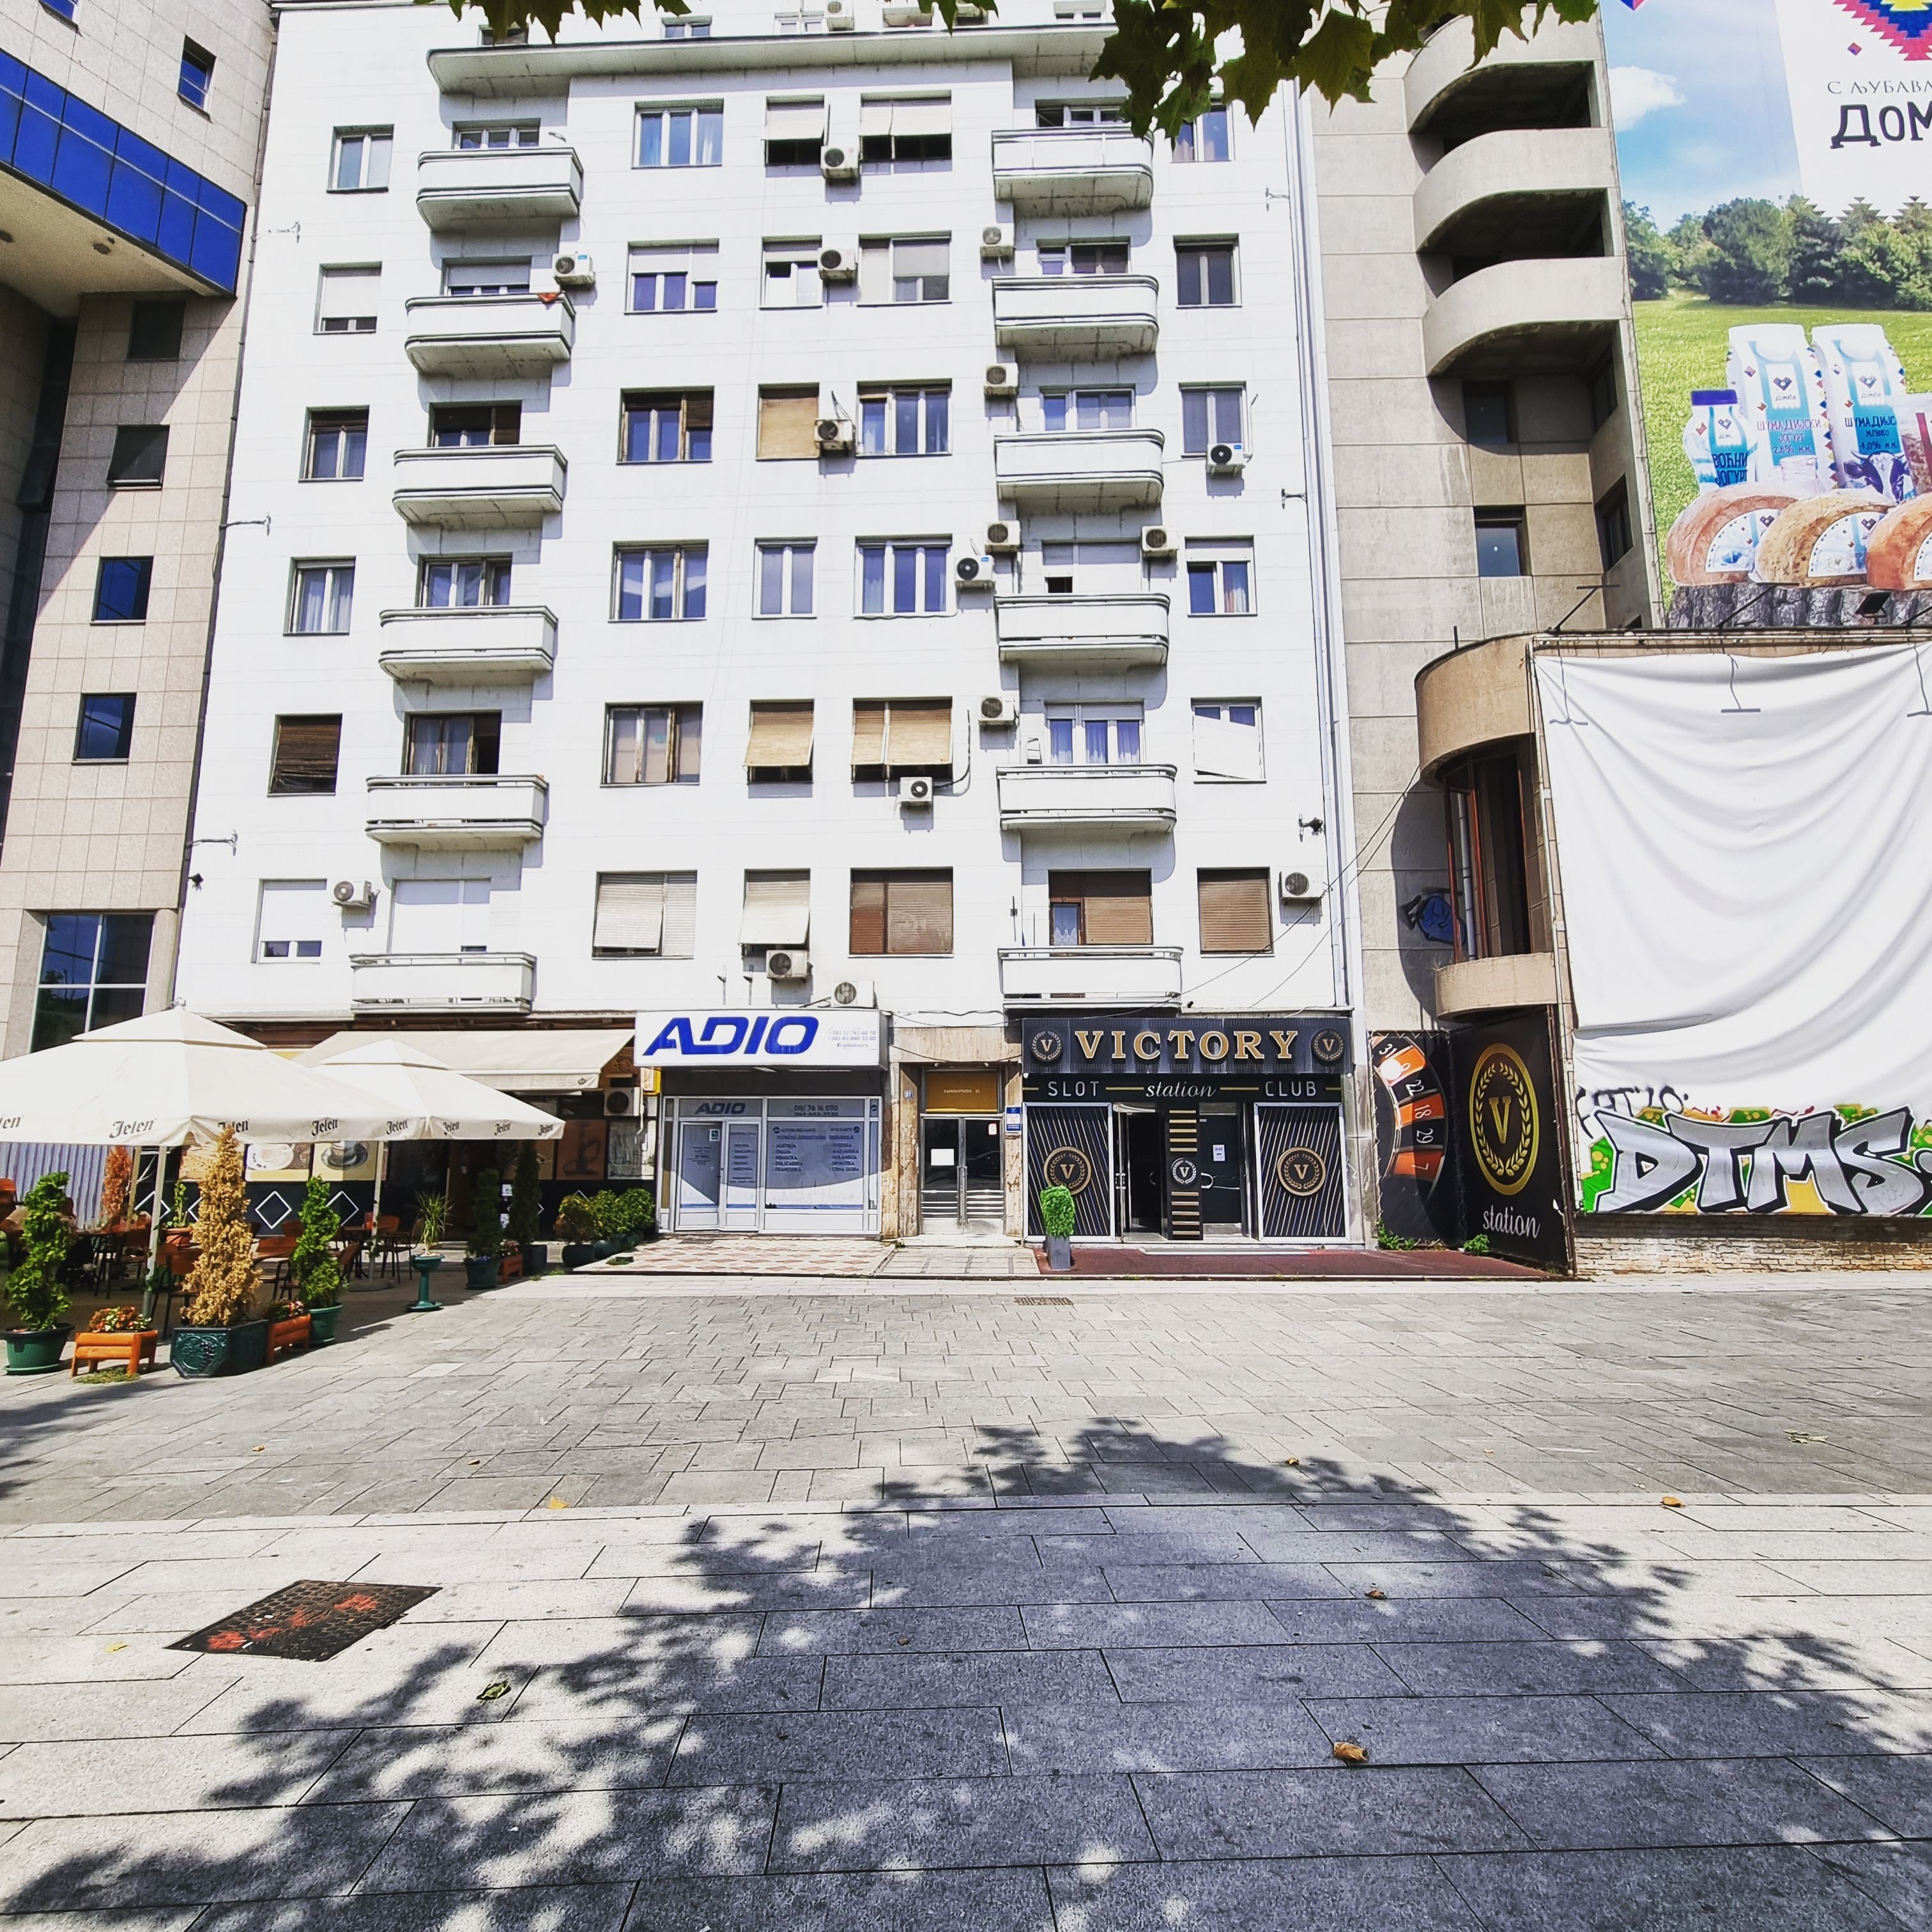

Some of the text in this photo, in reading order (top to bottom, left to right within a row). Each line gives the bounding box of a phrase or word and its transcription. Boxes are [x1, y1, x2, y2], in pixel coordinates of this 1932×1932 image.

[1827, 80, 1842, 95] С
[642, 1016, 820, 1056] ADIO
[1075, 1029, 1298, 1061] VICTORY
[1048, 1081, 1316, 1098] SLOT station CLUB
[1406, 1079, 1425, 1098] 22
[694, 1102, 746, 1115] ADIO
[1414, 1104, 1432, 1119] 18
[109, 1119, 155, 1138] Jelen
[311, 1119, 338, 1137] Jelen
[386, 1119, 408, 1135] Jelen
[1489, 1096, 1512, 1144] V
[493, 1123, 510, 1136] Jelen
[1416, 1128, 1434, 1144] 29
[1483, 1205, 1541, 1239] station
